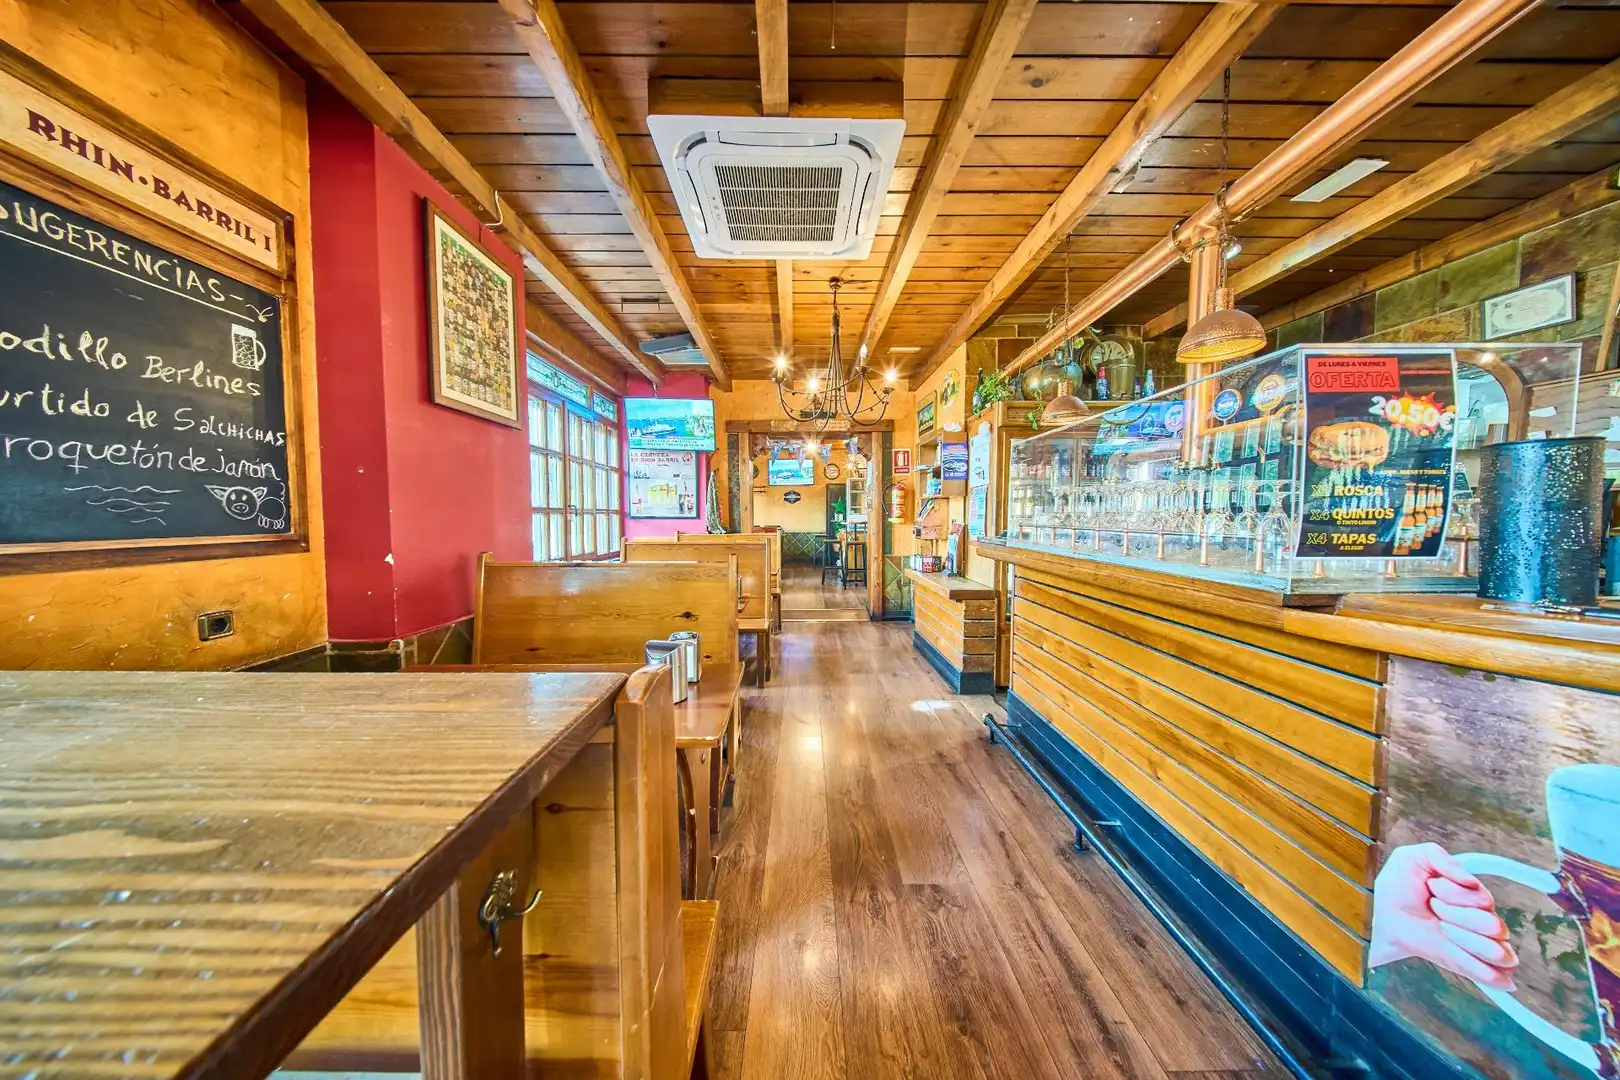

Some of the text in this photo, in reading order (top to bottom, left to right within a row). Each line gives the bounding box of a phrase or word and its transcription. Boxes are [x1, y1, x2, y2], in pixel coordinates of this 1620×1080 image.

[25, 107, 134, 184] RHIN
[151, 174, 256, 246] BARRIL
[140, 355, 261, 396] Berlines
[1310, 371, 1396, 389] OFERTA
[126, 400, 158, 429] de
[0, 434, 174, 475] roquetón
[178, 447, 208, 473] de
[1334, 484, 1384, 497] ROSCA
[1309, 508, 1395, 521] X4 QUINTOS
[1306, 532, 1377, 545] X4 TAPAS
